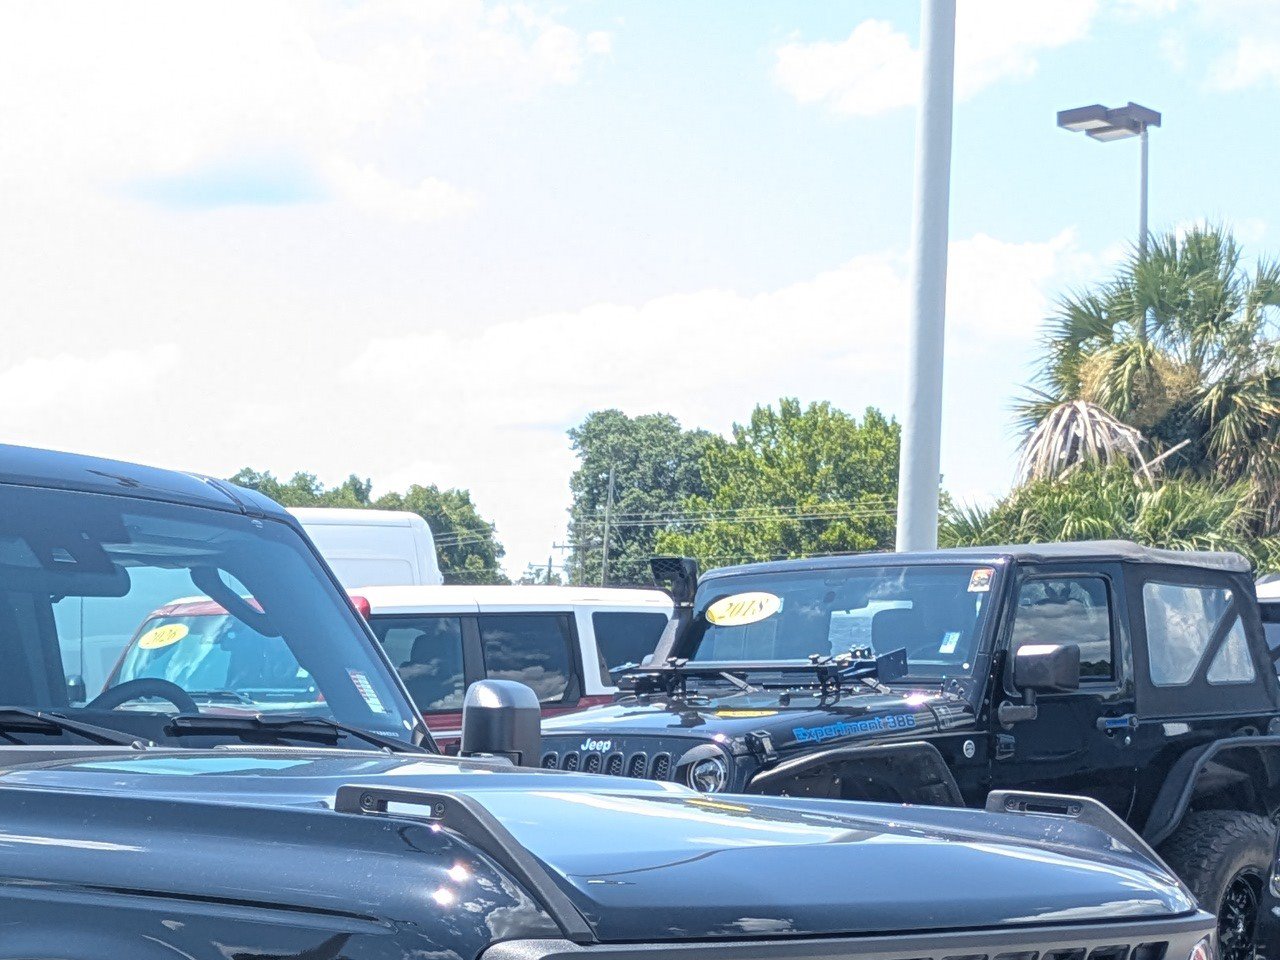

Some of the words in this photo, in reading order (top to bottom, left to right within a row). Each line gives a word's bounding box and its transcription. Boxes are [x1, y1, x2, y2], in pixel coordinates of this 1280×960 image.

[793, 718, 883, 742] Experiment
[885, 714, 916, 729] 386
[581, 738, 611, 753] Jeep
